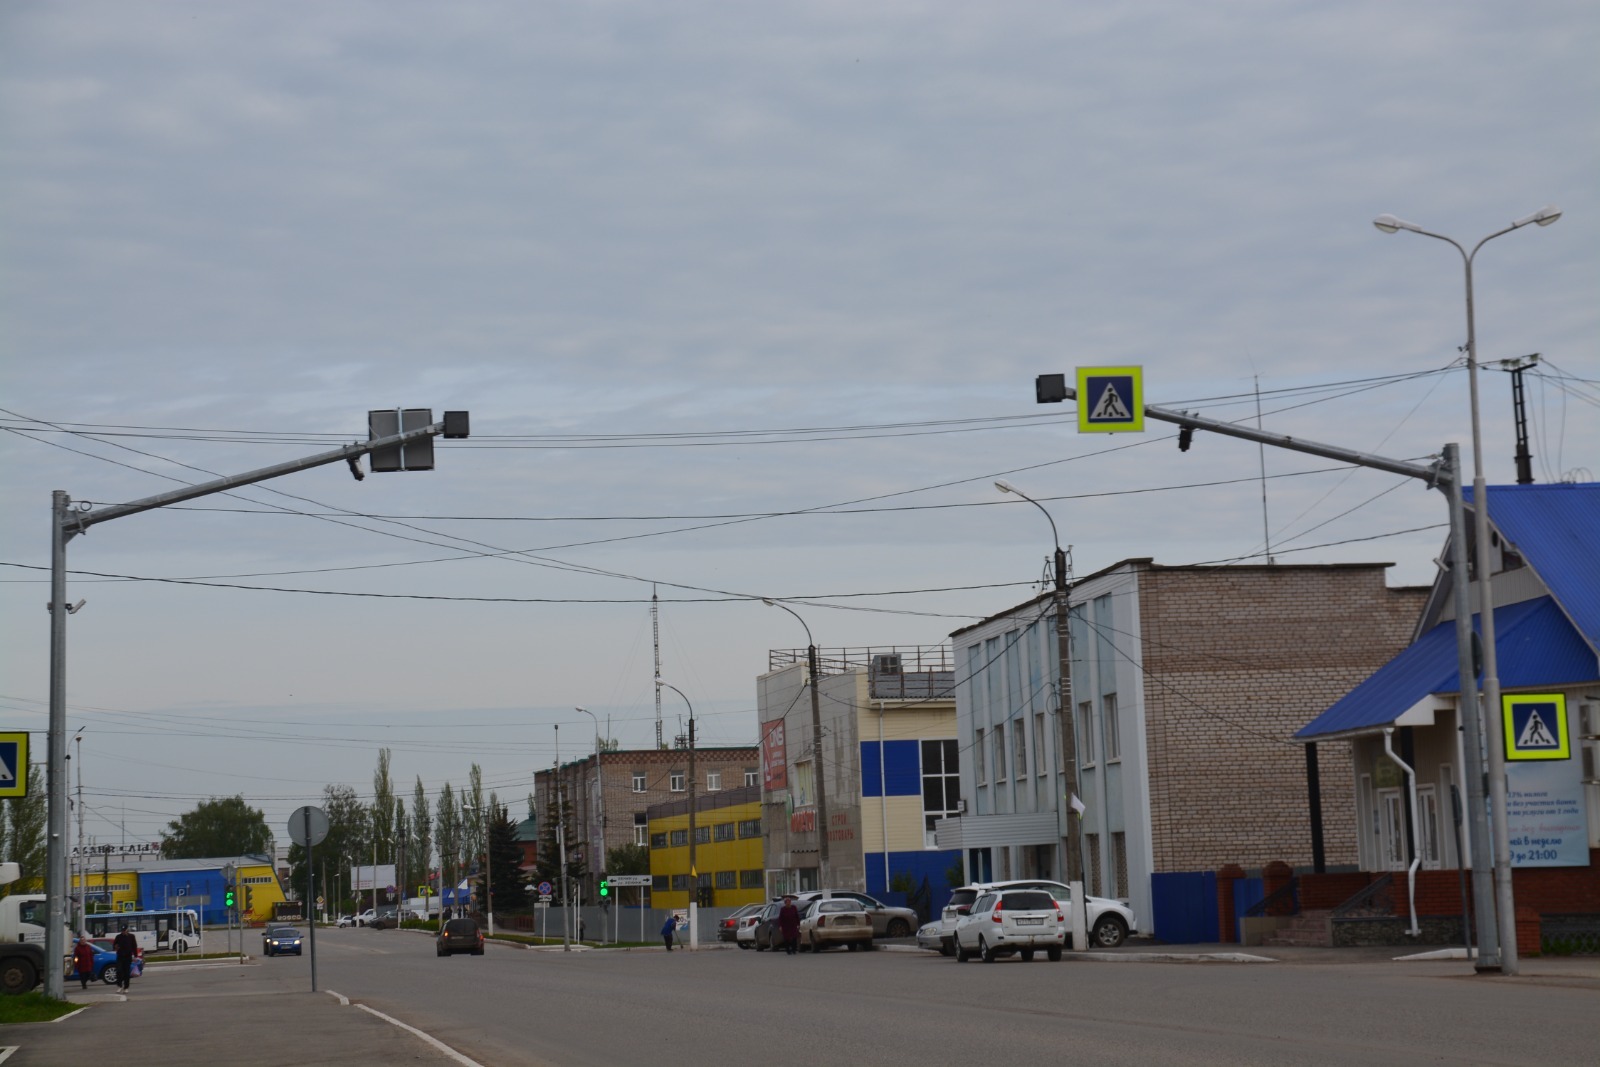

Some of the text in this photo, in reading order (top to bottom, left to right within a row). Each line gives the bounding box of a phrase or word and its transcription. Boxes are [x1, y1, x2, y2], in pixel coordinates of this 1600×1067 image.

[1522, 809, 1545, 817] услуги
[1524, 836, 1530, 845] в
[1531, 837, 1562, 848] неделю
[1516, 853, 1526, 863] до
[1529, 850, 1557, 860] 21:00
